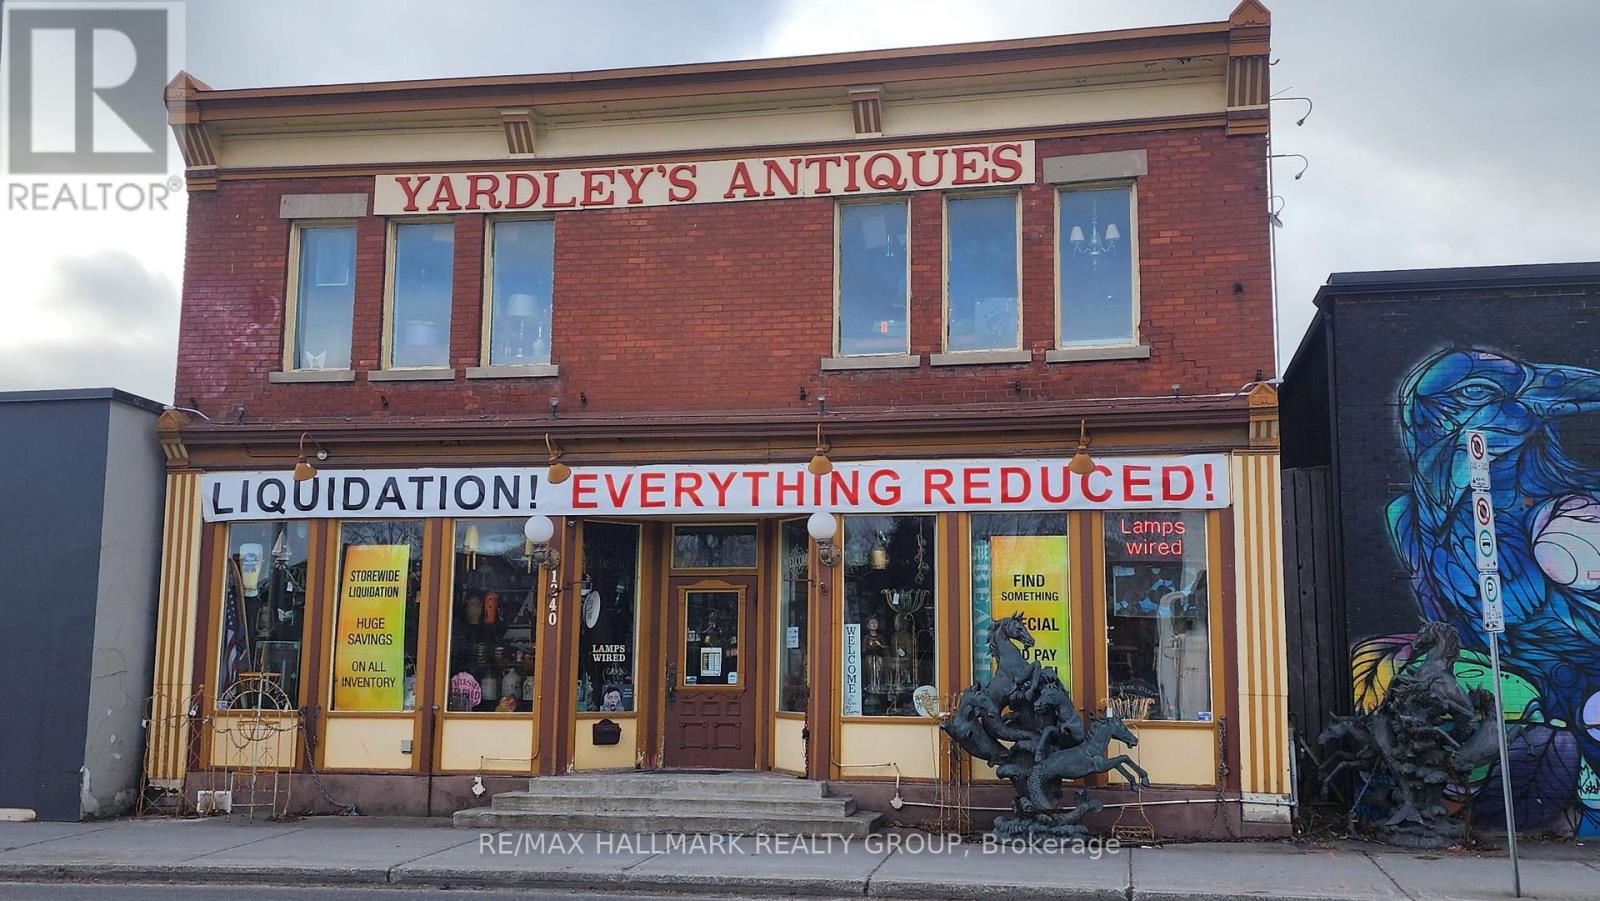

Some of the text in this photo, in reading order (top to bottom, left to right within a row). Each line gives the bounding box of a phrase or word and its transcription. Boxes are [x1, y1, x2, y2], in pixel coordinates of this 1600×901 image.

[395, 143, 1024, 212] YARDLEY'S ANTIQUES
[212, 463, 1215, 515] LIQUIDATION! EVERYTHING REDUCED!
[1120, 518, 1186, 537] Lamps
[1126, 539, 1183, 556] wired
[350, 569, 400, 582] STOREWIDE
[1013, 574, 1046, 588] FIND
[348, 586, 399, 599] LIQUIDATION
[548, 570, 559, 626] 1240
[1001, 591, 1059, 602] SOMETHING
[356, 617, 385, 630] HUGE
[347, 633, 393, 646] SAVINGS
[592, 644, 626, 653] LAMPS
[1034, 649, 1058, 661] PAY
[592, 653, 626, 662] WIRED
[846, 626, 857, 694] WELCOME
[351, 660, 386, 673] ON ALL
[341, 677, 397, 689] INVENTORY
